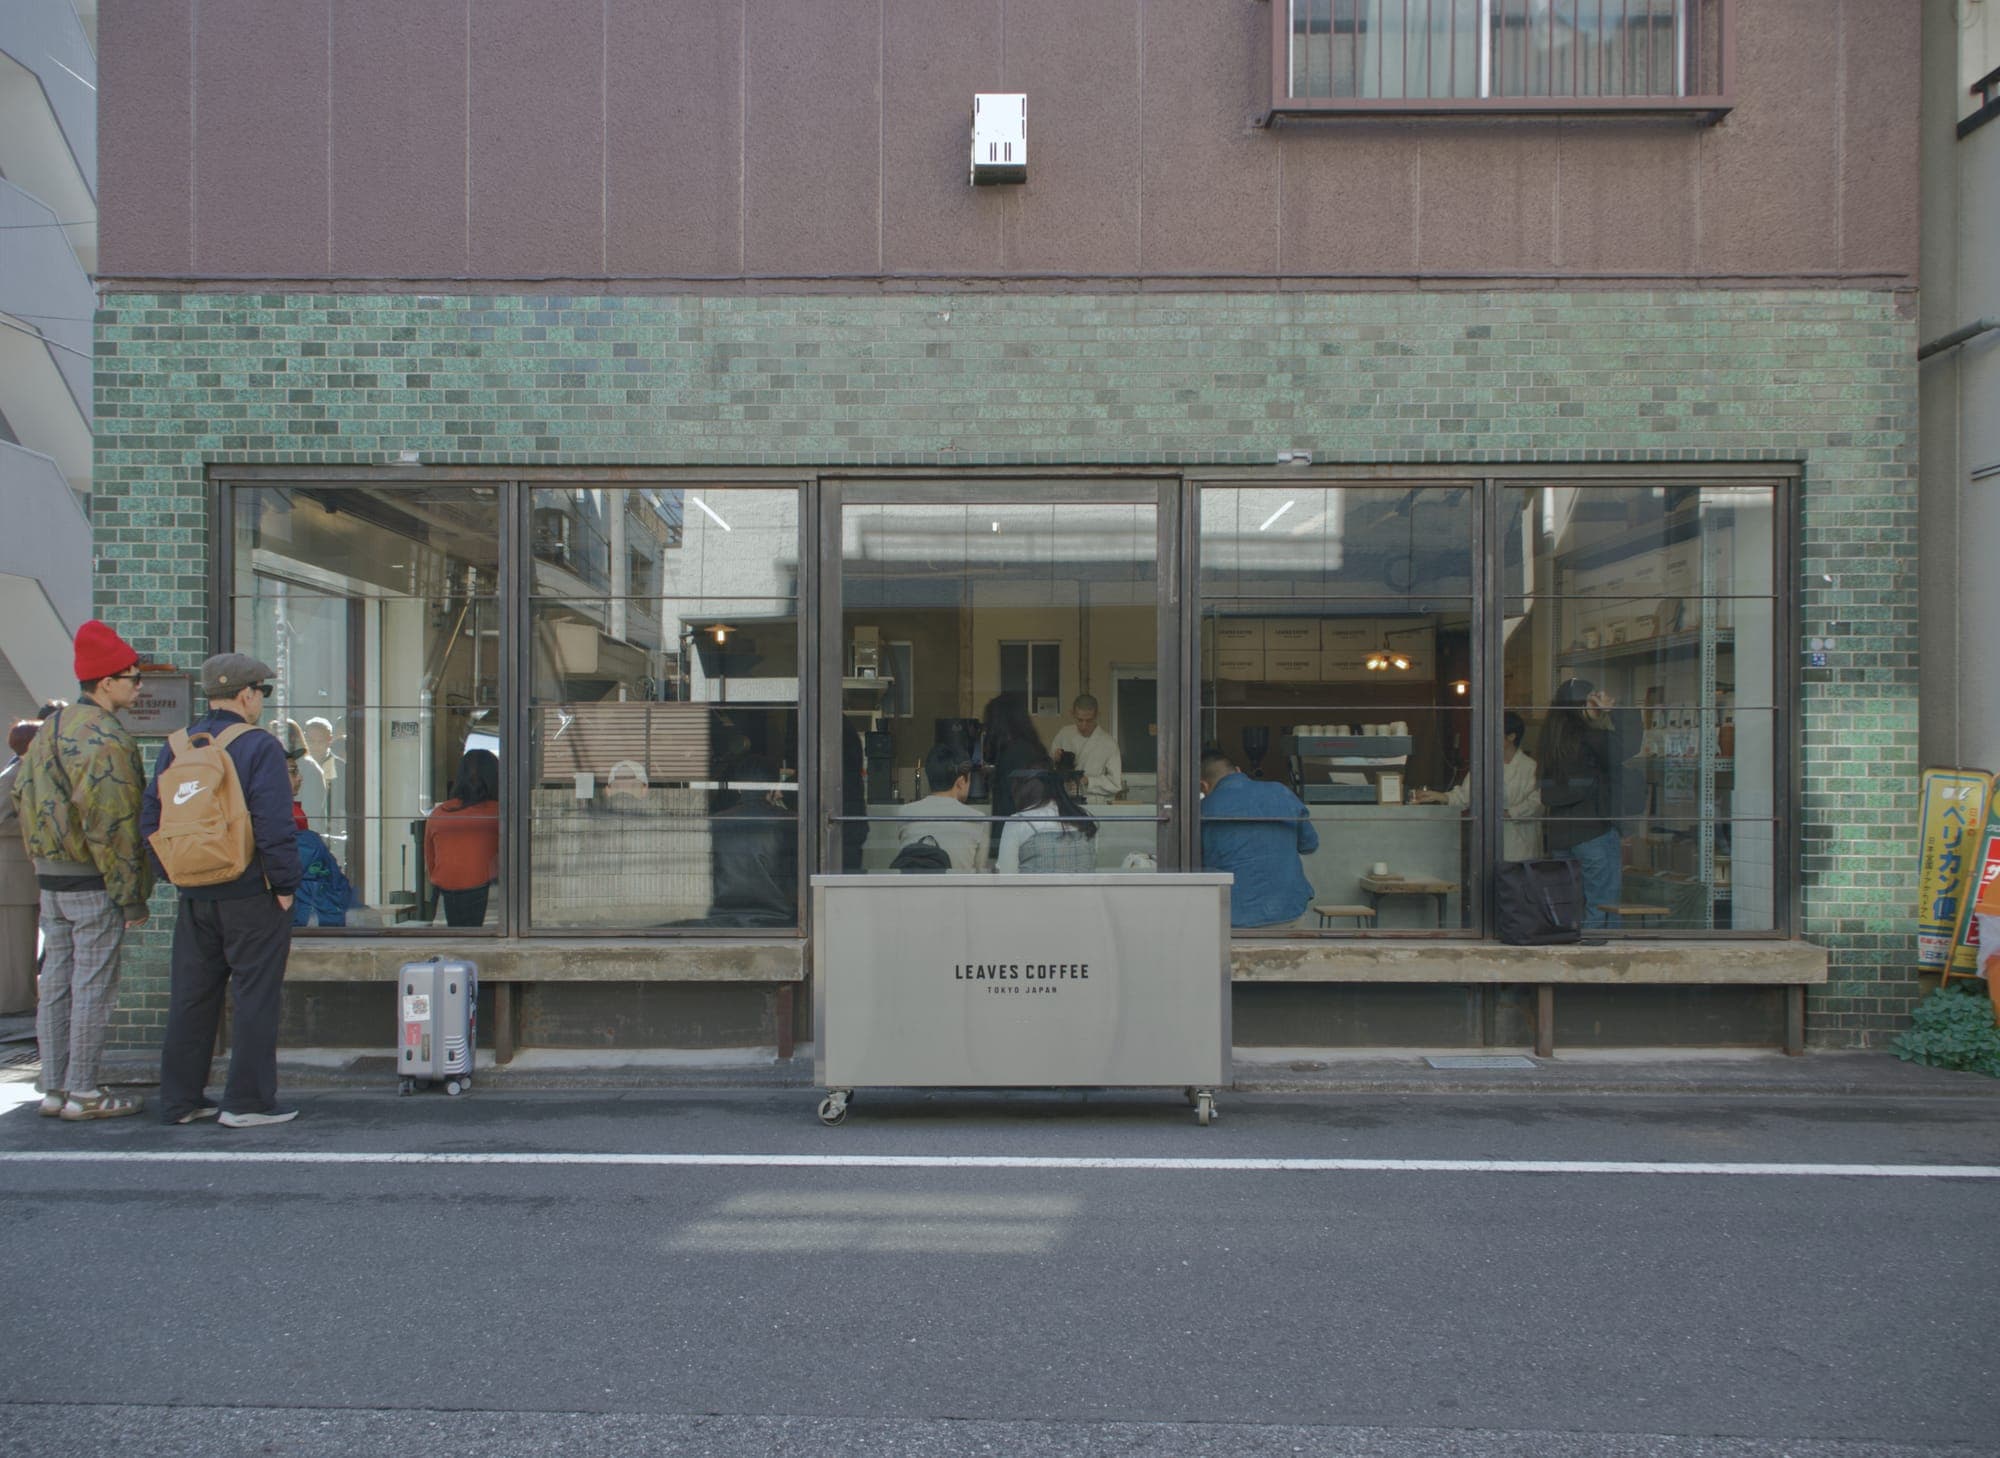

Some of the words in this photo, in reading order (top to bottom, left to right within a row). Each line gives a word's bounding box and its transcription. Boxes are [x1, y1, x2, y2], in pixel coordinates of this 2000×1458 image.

[178, 780, 200, 796] NIKE
[1933, 804, 1967, 921] ペリカン便
[955, 964, 1019, 980] LEAVES
[1026, 964, 1089, 979] COFFEE
[987, 986, 1020, 994] TOKYO
[1025, 986, 1057, 994] JAPAN
